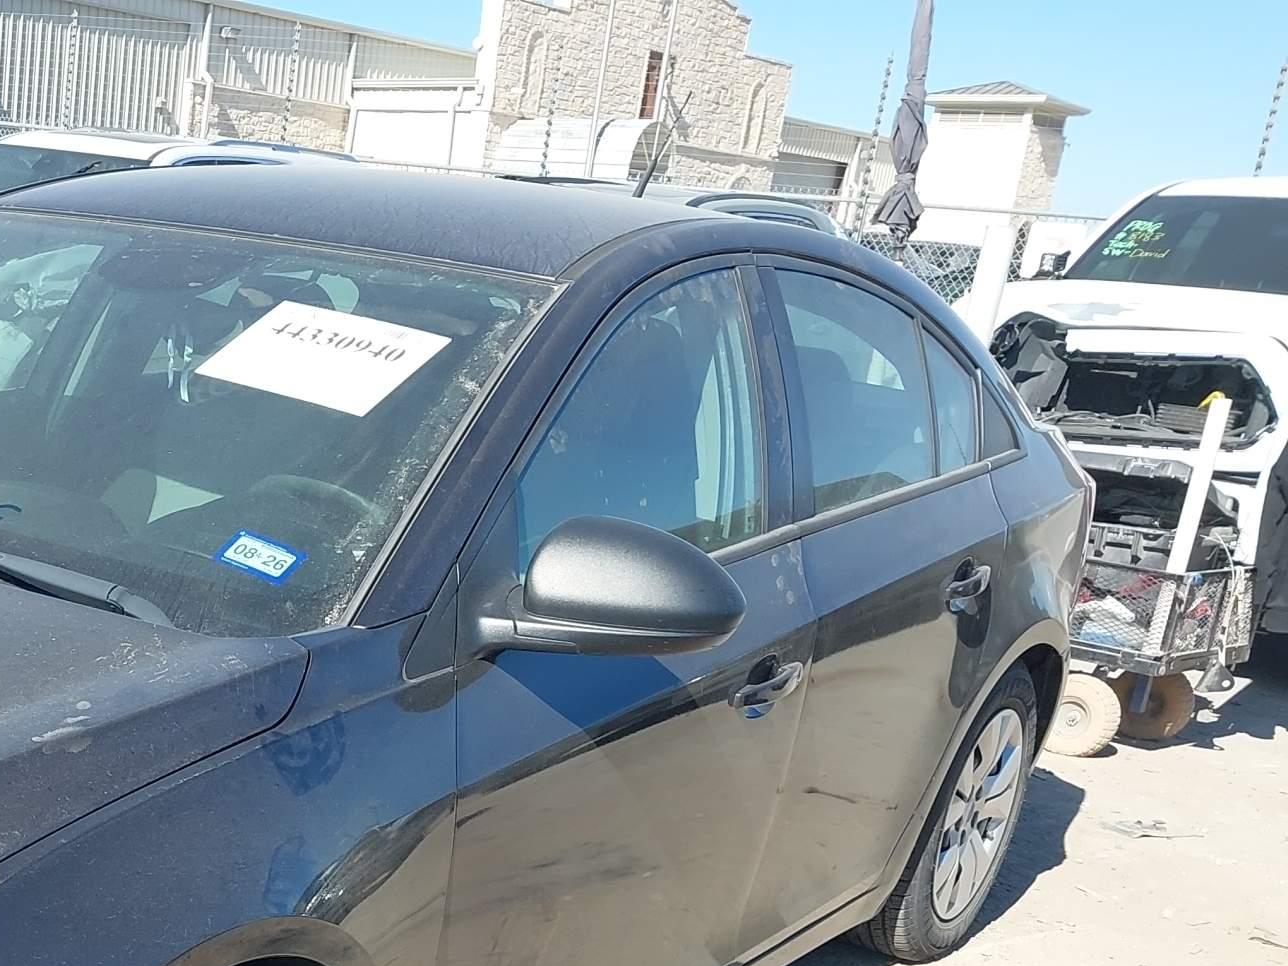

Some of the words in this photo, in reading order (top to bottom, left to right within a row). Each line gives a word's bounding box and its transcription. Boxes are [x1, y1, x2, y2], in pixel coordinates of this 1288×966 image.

[272, 322, 406, 362] 44330940
[233, 543, 258, 559] 08
[261, 554, 288, 571] 26
